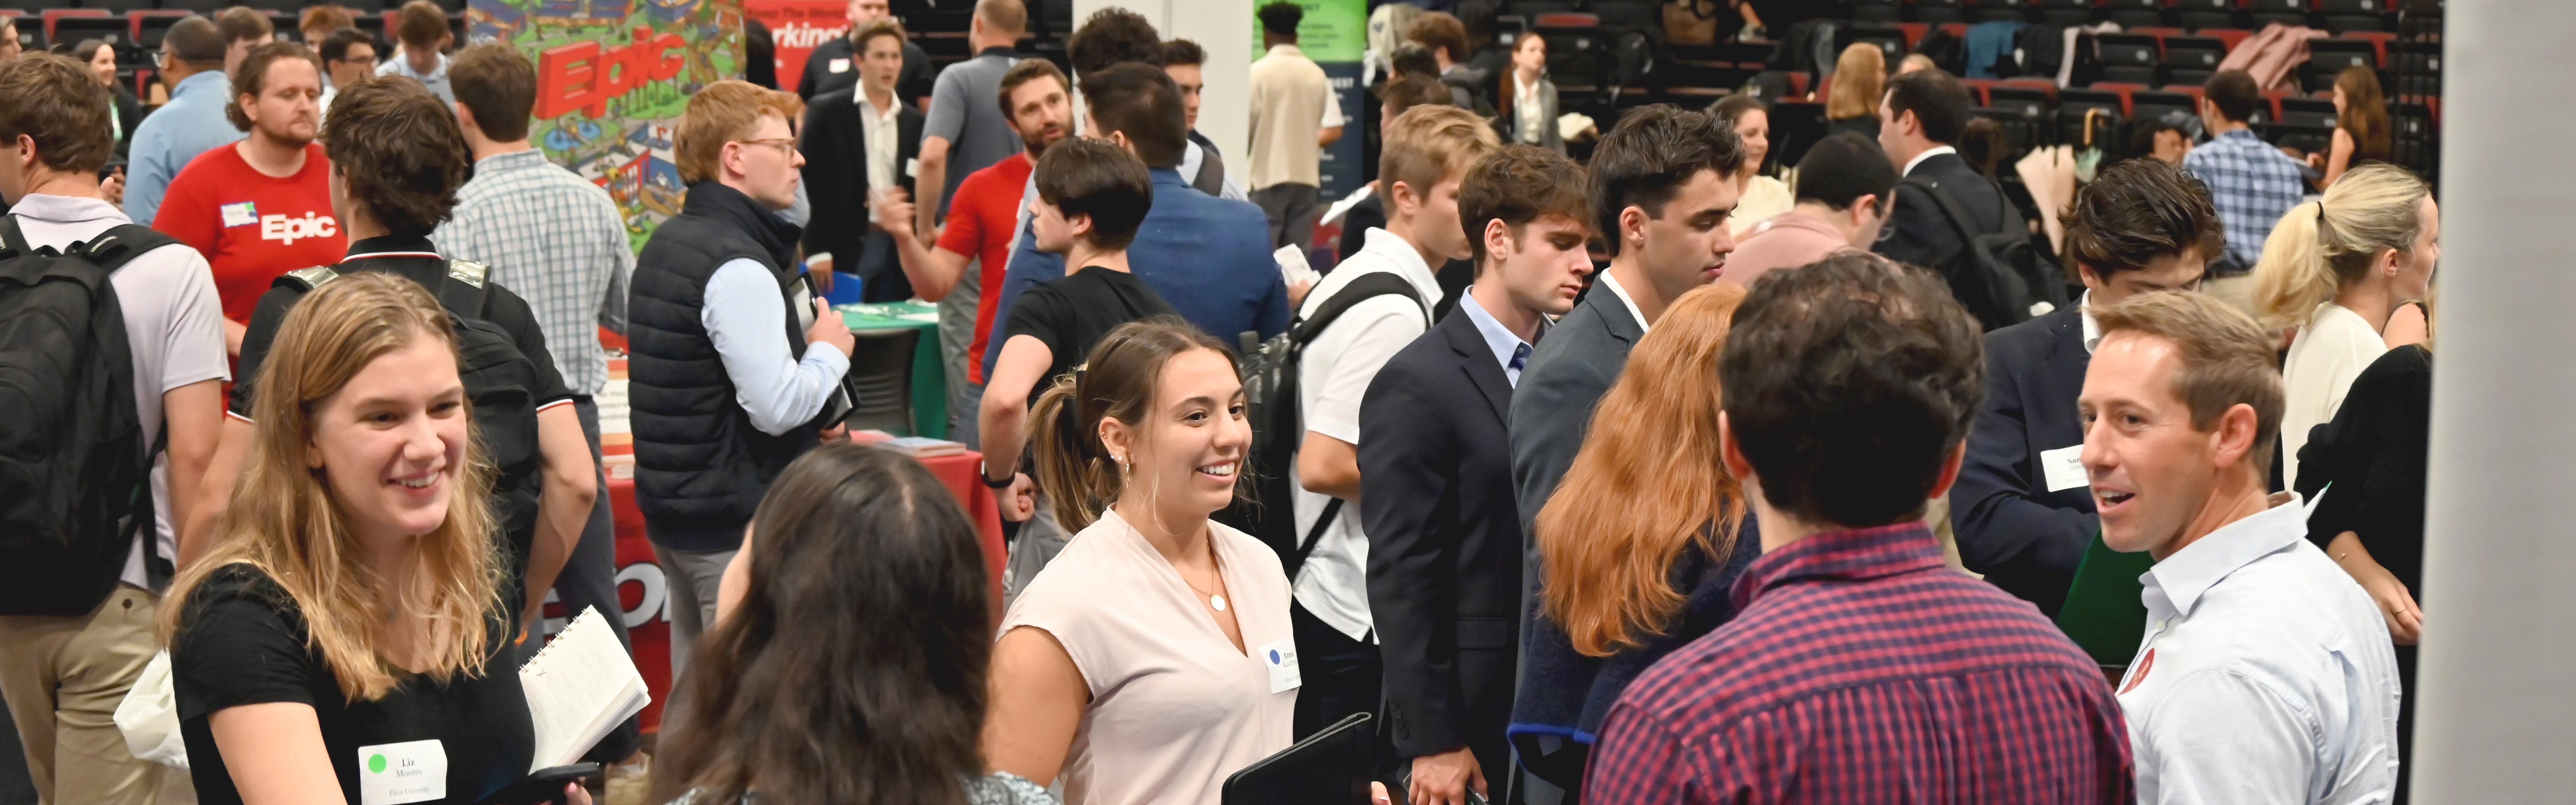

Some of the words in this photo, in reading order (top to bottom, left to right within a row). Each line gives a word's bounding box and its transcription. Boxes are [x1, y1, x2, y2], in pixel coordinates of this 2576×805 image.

[534, 24, 686, 120] Epic
[261, 211, 336, 245] Epic
[1284, 652, 1294, 660] Anna
[402, 757, 415, 767] Liz
[396, 769, 422, 778] Moores
[405, 786, 431, 795] University
